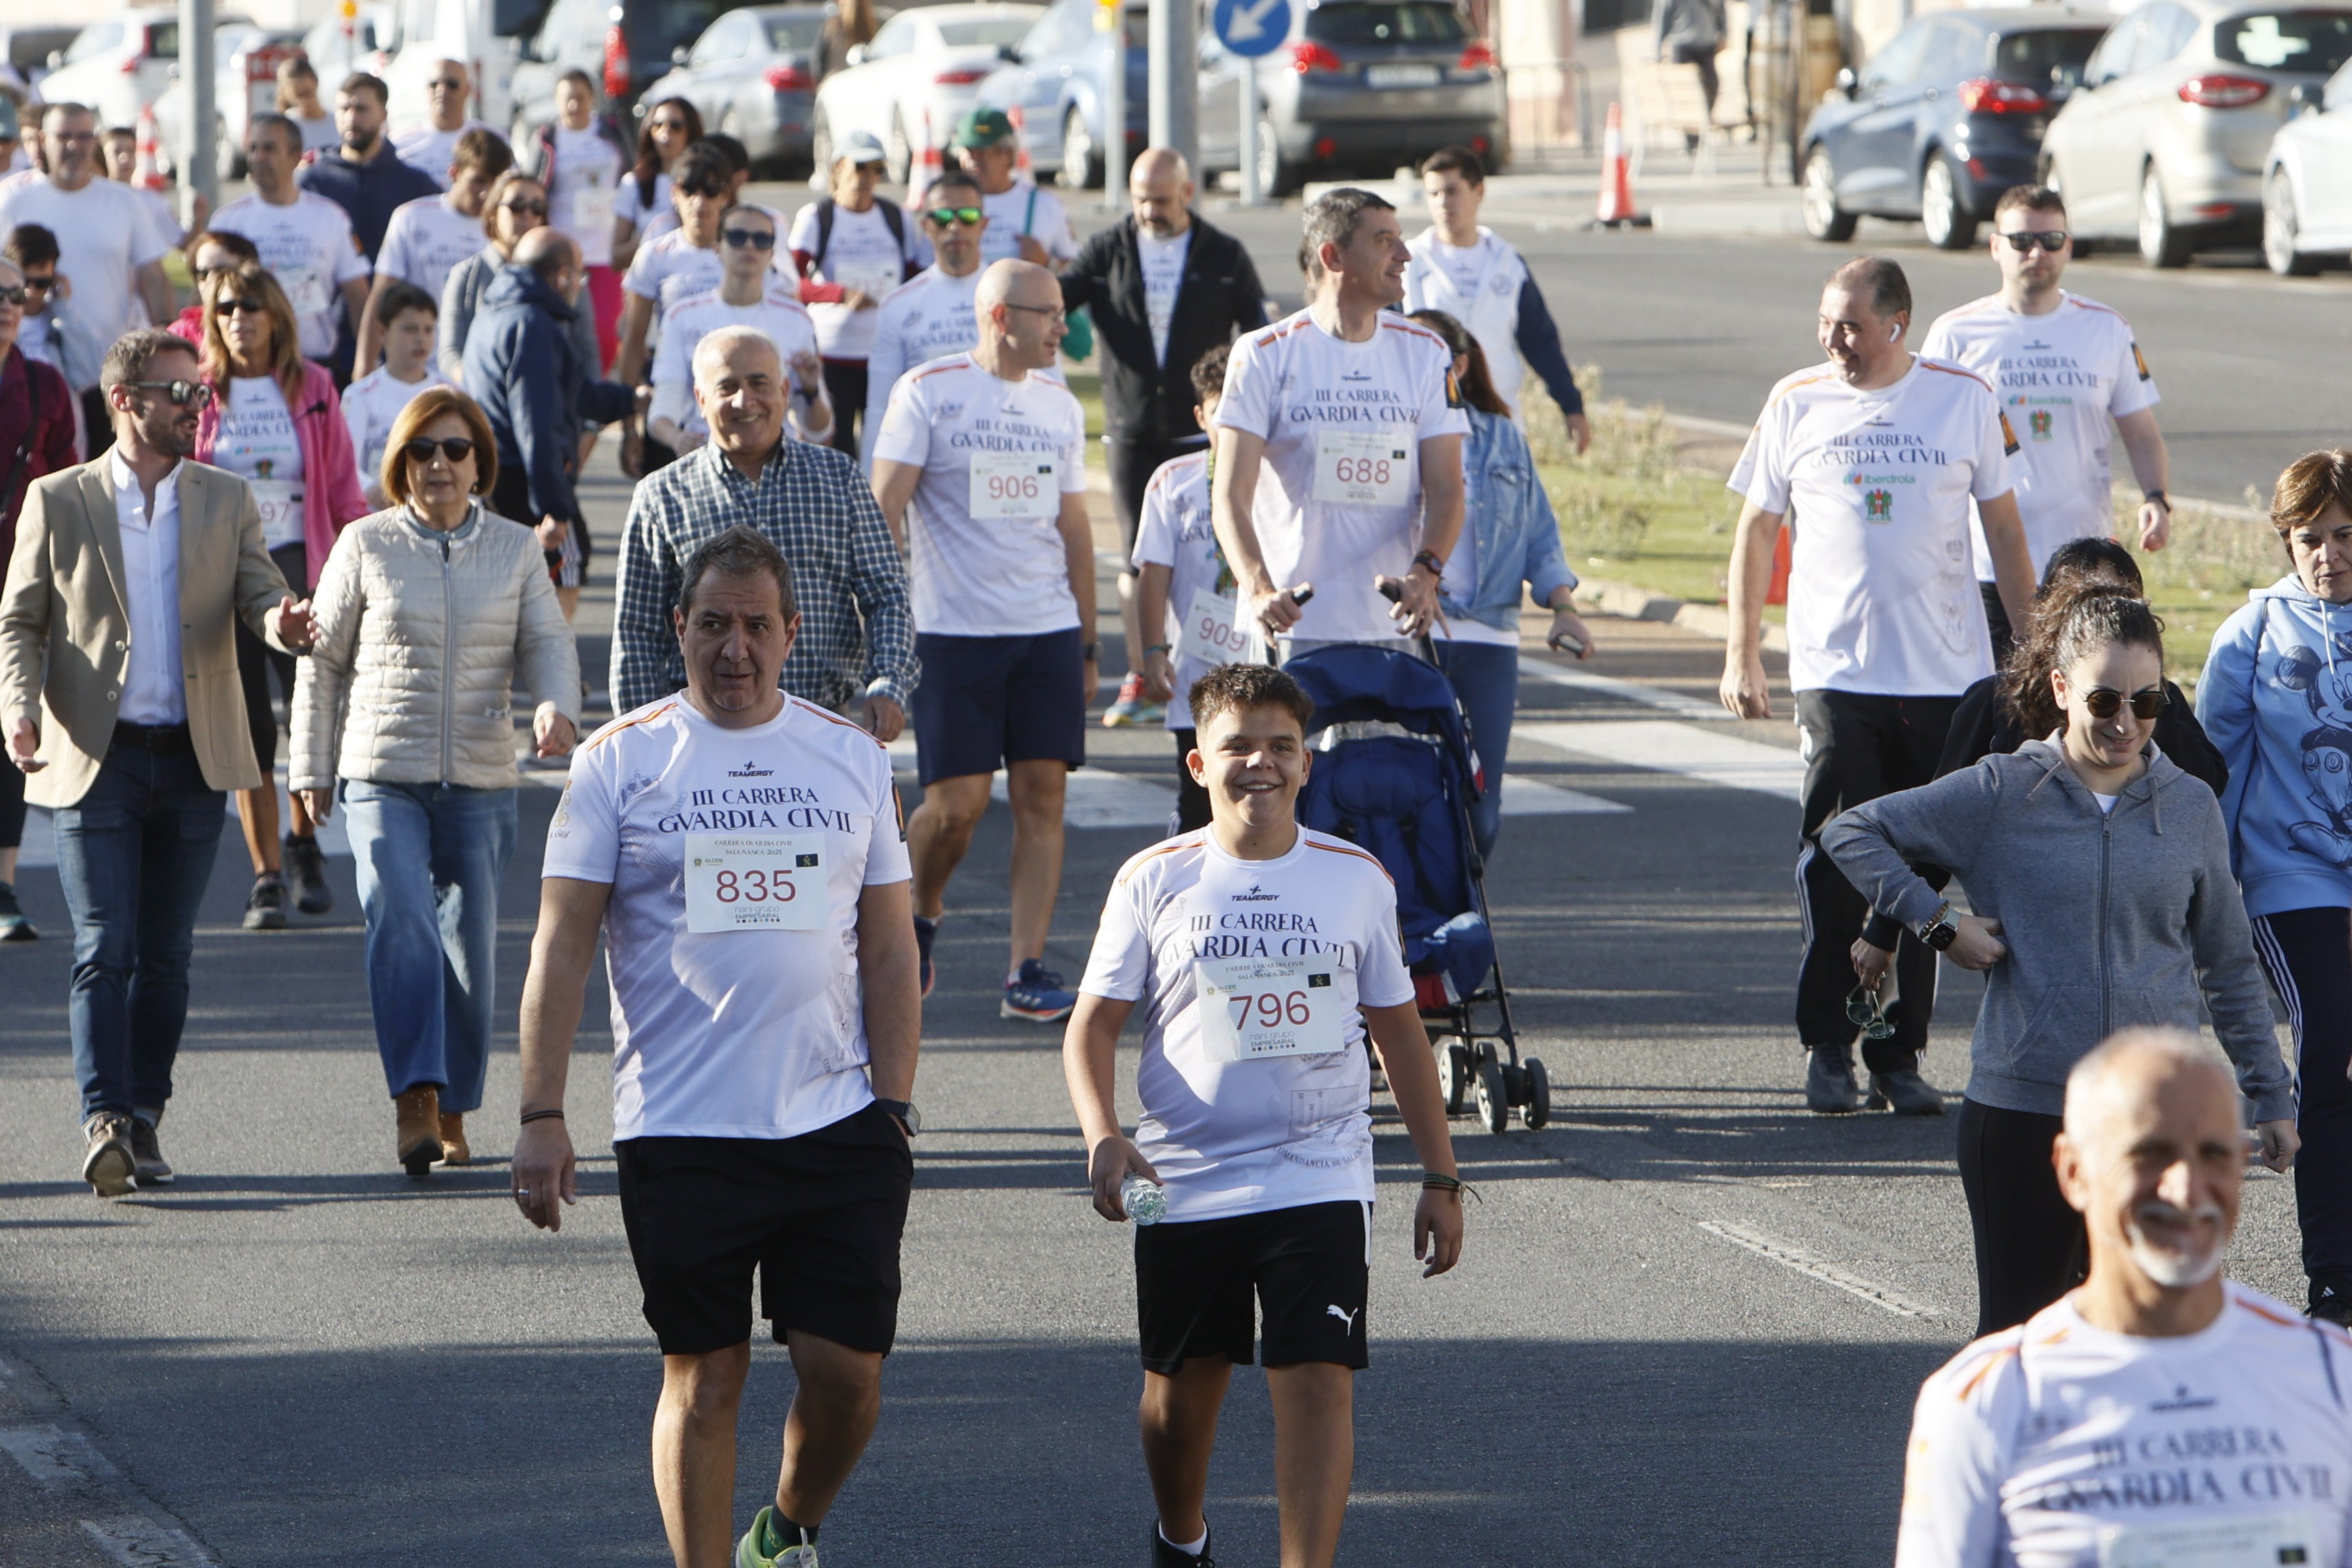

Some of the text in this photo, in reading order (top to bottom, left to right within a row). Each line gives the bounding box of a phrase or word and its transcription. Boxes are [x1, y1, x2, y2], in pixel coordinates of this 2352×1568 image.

[2017, 356, 2079, 369] CARRERA
[2001, 371, 2097, 388] ARDIA CIVIL
[1315, 389, 1401, 404] III CARRERA
[1291, 405, 1373, 423] GVARDIA
[975, 418, 1050, 439] III CARRERA
[951, 433, 1025, 452] GVARDIA
[1833, 433, 1924, 446] III CARRERA
[1810, 448, 1950, 469] GVARDIA CIVIL
[1336, 457, 1390, 484] 688
[988, 475, 1038, 500] 906
[727, 769, 774, 778] TEAMERGY
[691, 787, 821, 807] III CARRERA
[658, 807, 856, 835] GVARDIA CIVIL
[716, 870, 796, 903] 835
[1231, 894, 1281, 902] TEAMERGY
[755, 905, 780, 914] grupo
[1190, 913, 1320, 934] III CARRERA
[1162, 934, 1268, 966] GVARDIA
[1225, 965, 1257, 973] CARRERA
[1229, 990, 1311, 1031] 796
[1251, 1039, 1295, 1048] EMPRESARIAL
[1269, 1030, 1295, 1043] grupo
[2091, 1426, 2287, 1469] III CARRERA
